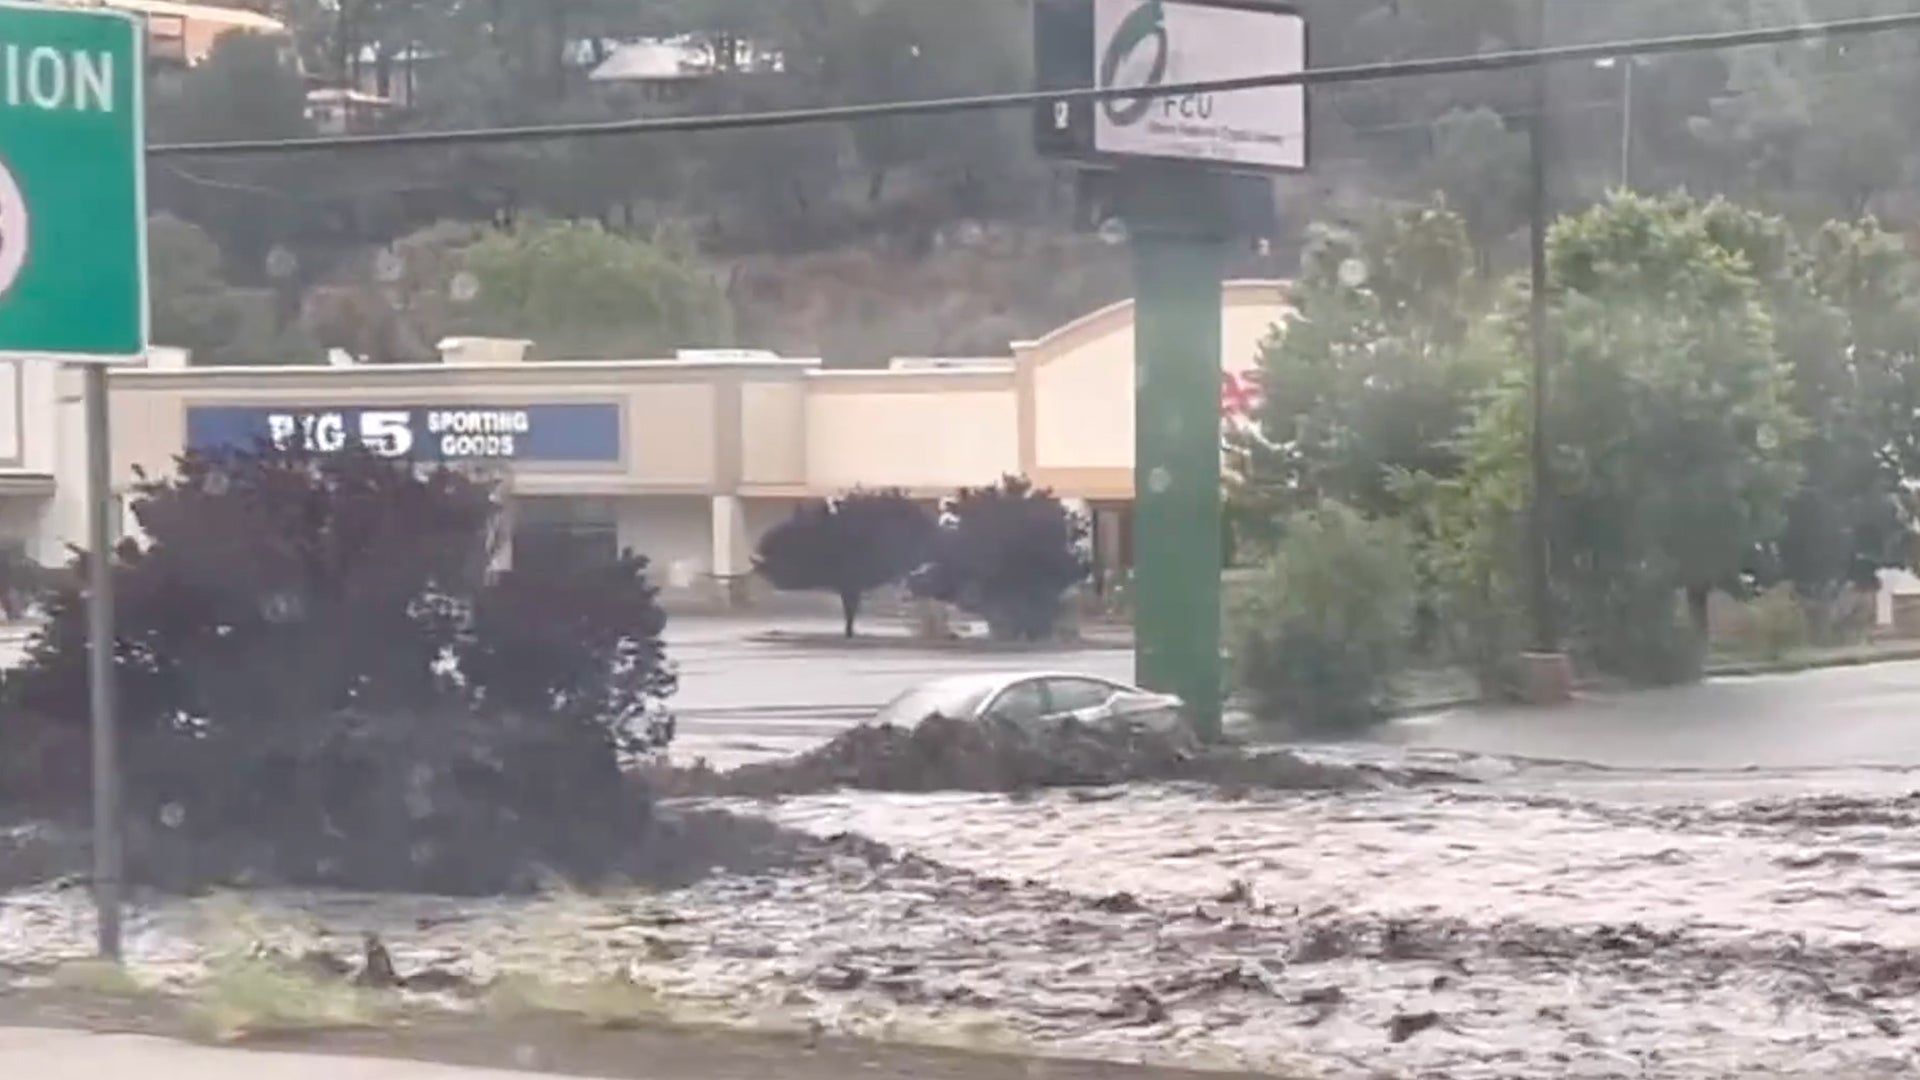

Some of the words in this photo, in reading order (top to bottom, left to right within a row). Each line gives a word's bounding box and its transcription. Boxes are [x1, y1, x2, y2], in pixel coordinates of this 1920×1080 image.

[6, 45, 114, 112] ION
[360, 411, 413, 457] 5
[428, 411, 529, 433] SPORTING
[441, 434, 514, 456] GOODS
